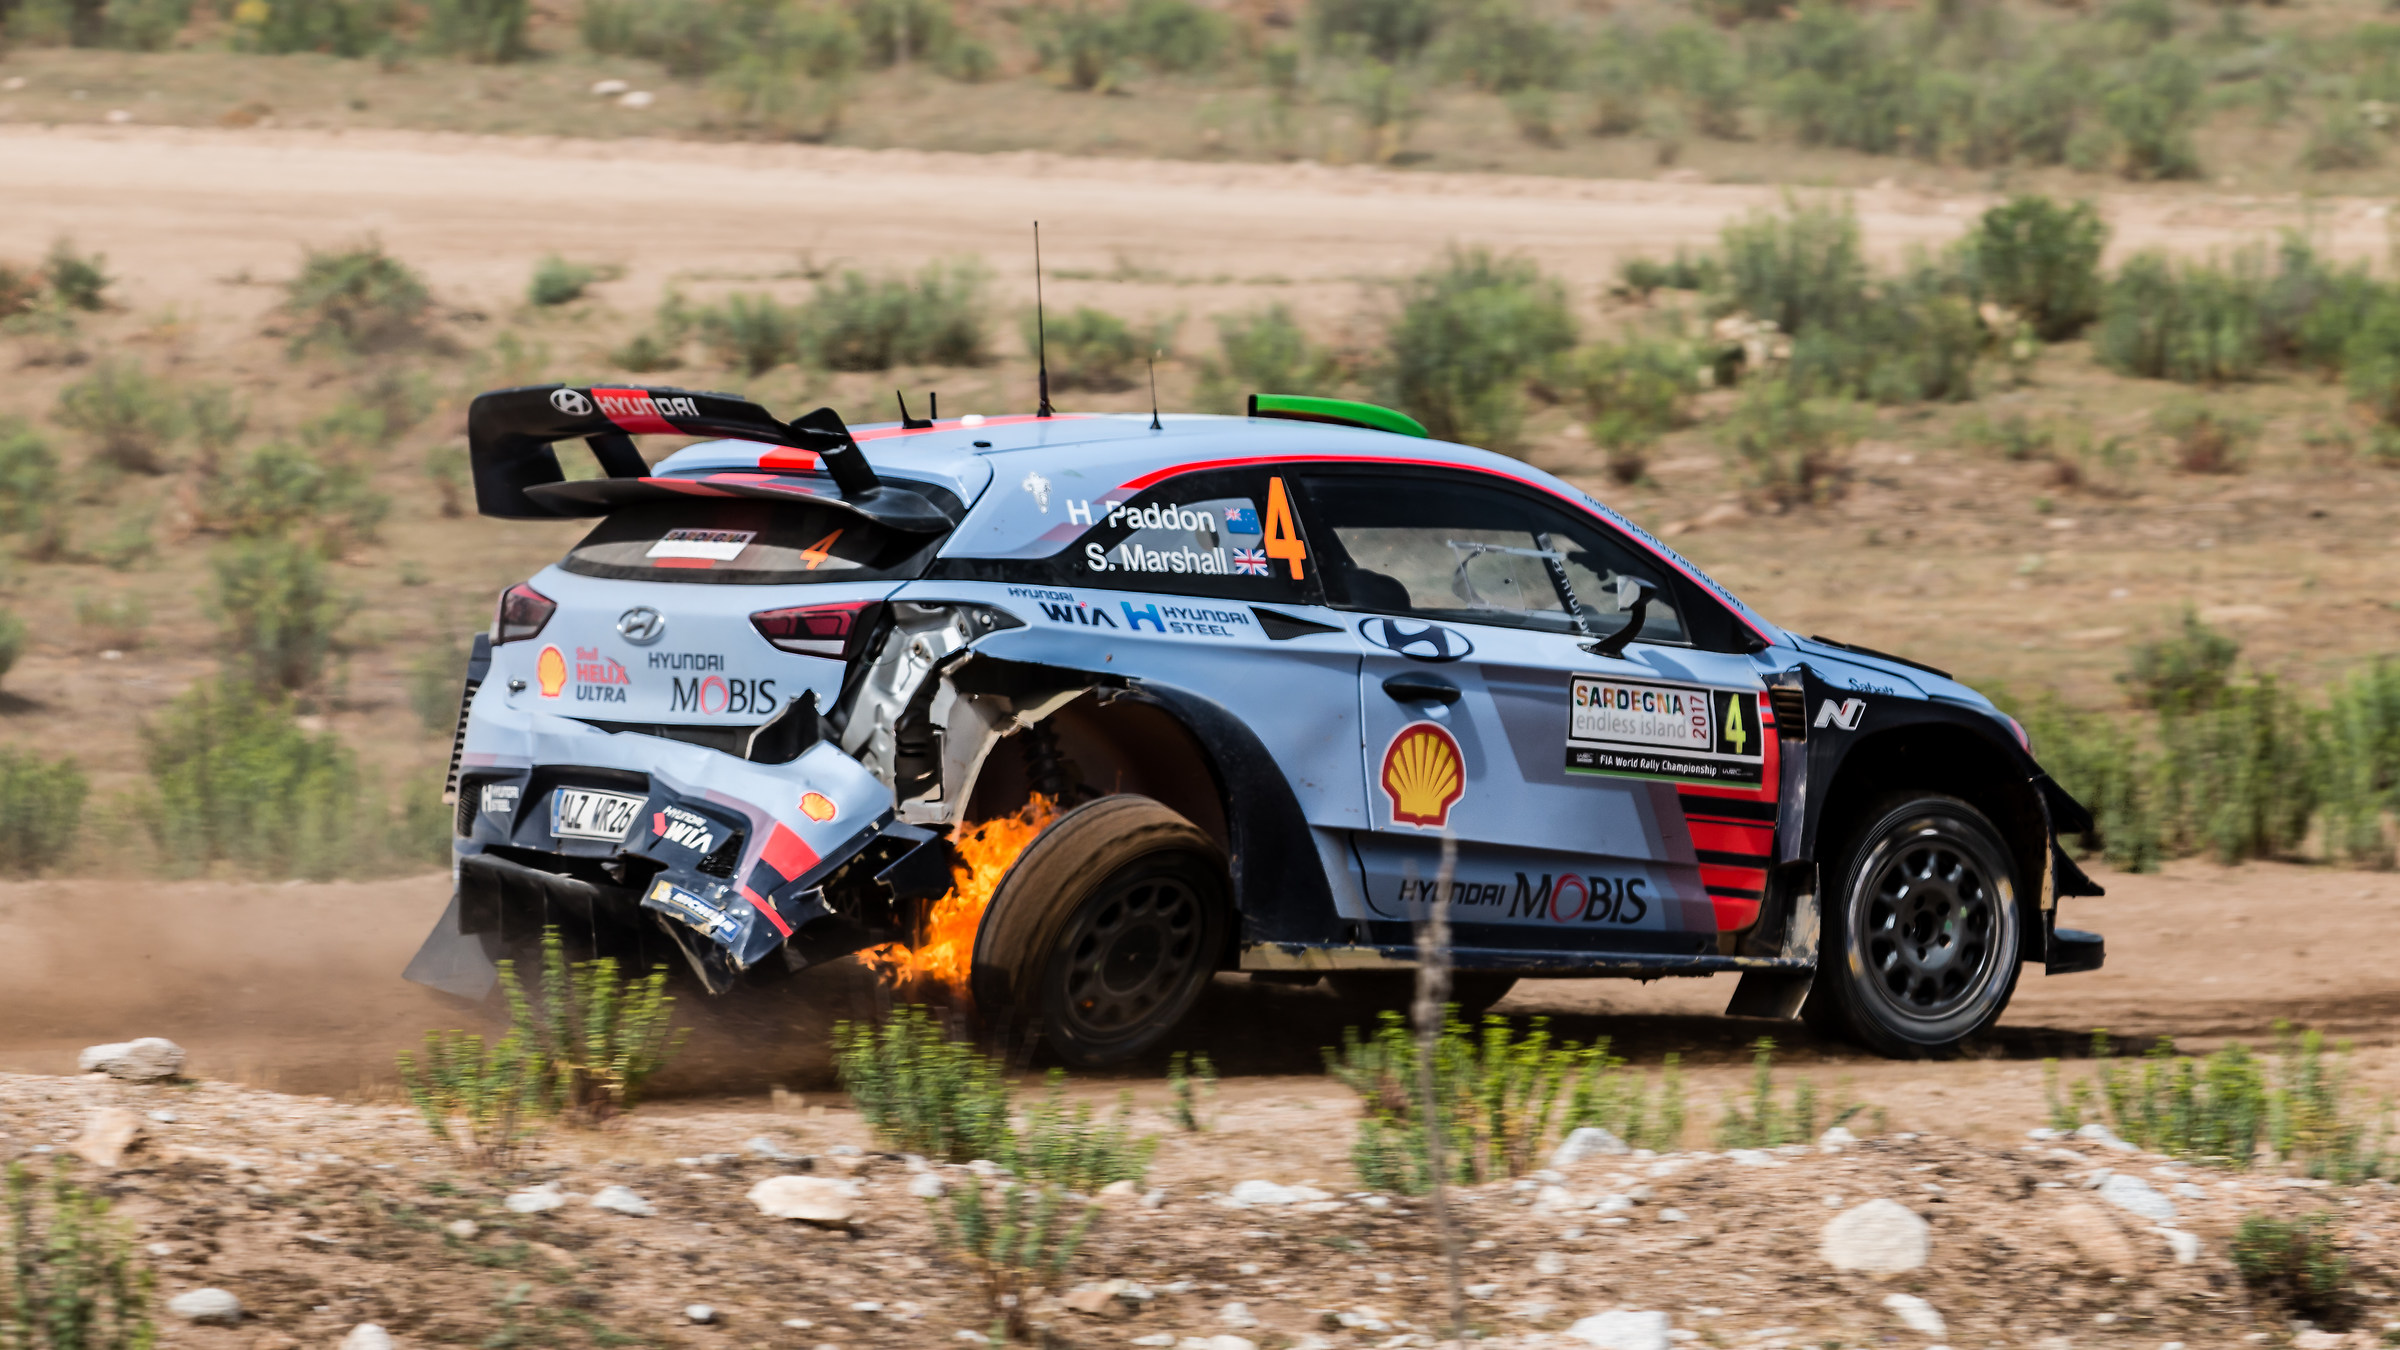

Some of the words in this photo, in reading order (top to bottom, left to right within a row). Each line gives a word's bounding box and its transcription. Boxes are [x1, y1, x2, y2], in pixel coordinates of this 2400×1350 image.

[594, 396, 699, 416] HYUNDAI
[1066, 499, 1099, 526] H.
[1105, 500, 1217, 532] Paddon
[1264, 476, 1306, 580] 4
[800, 528, 845, 570] 4
[1085, 542, 1116, 572] S.
[1119, 543, 1229, 575] Marshall
[1584, 494, 1744, 610] motorsport.hyundai.com
[1008, 587, 1074, 601] HYUNDAI
[1039, 601, 1119, 628] WIA
[1163, 606, 1250, 624] HYUNDAI
[1169, 621, 1235, 637] STEEL
[576, 659, 631, 685] HELIX
[648, 652, 725, 671] HYUNDAI
[576, 685, 626, 703] ULTRA
[669, 675, 777, 715] MOBIS
[1576, 685, 1685, 716] SARDEGNA
[1576, 711, 1636, 734] endless
[1641, 715, 1687, 738] island
[1690, 695, 1708, 740] 2017
[1724, 693, 1747, 754] 4
[1600, 754, 1613, 766] FIA
[1615, 756, 1639, 768] World
[1640, 758, 1660, 772] Rally
[1662, 760, 1717, 777] Championship
[591, 797, 636, 833] WR26
[1508, 872, 1647, 924] MOBIS
